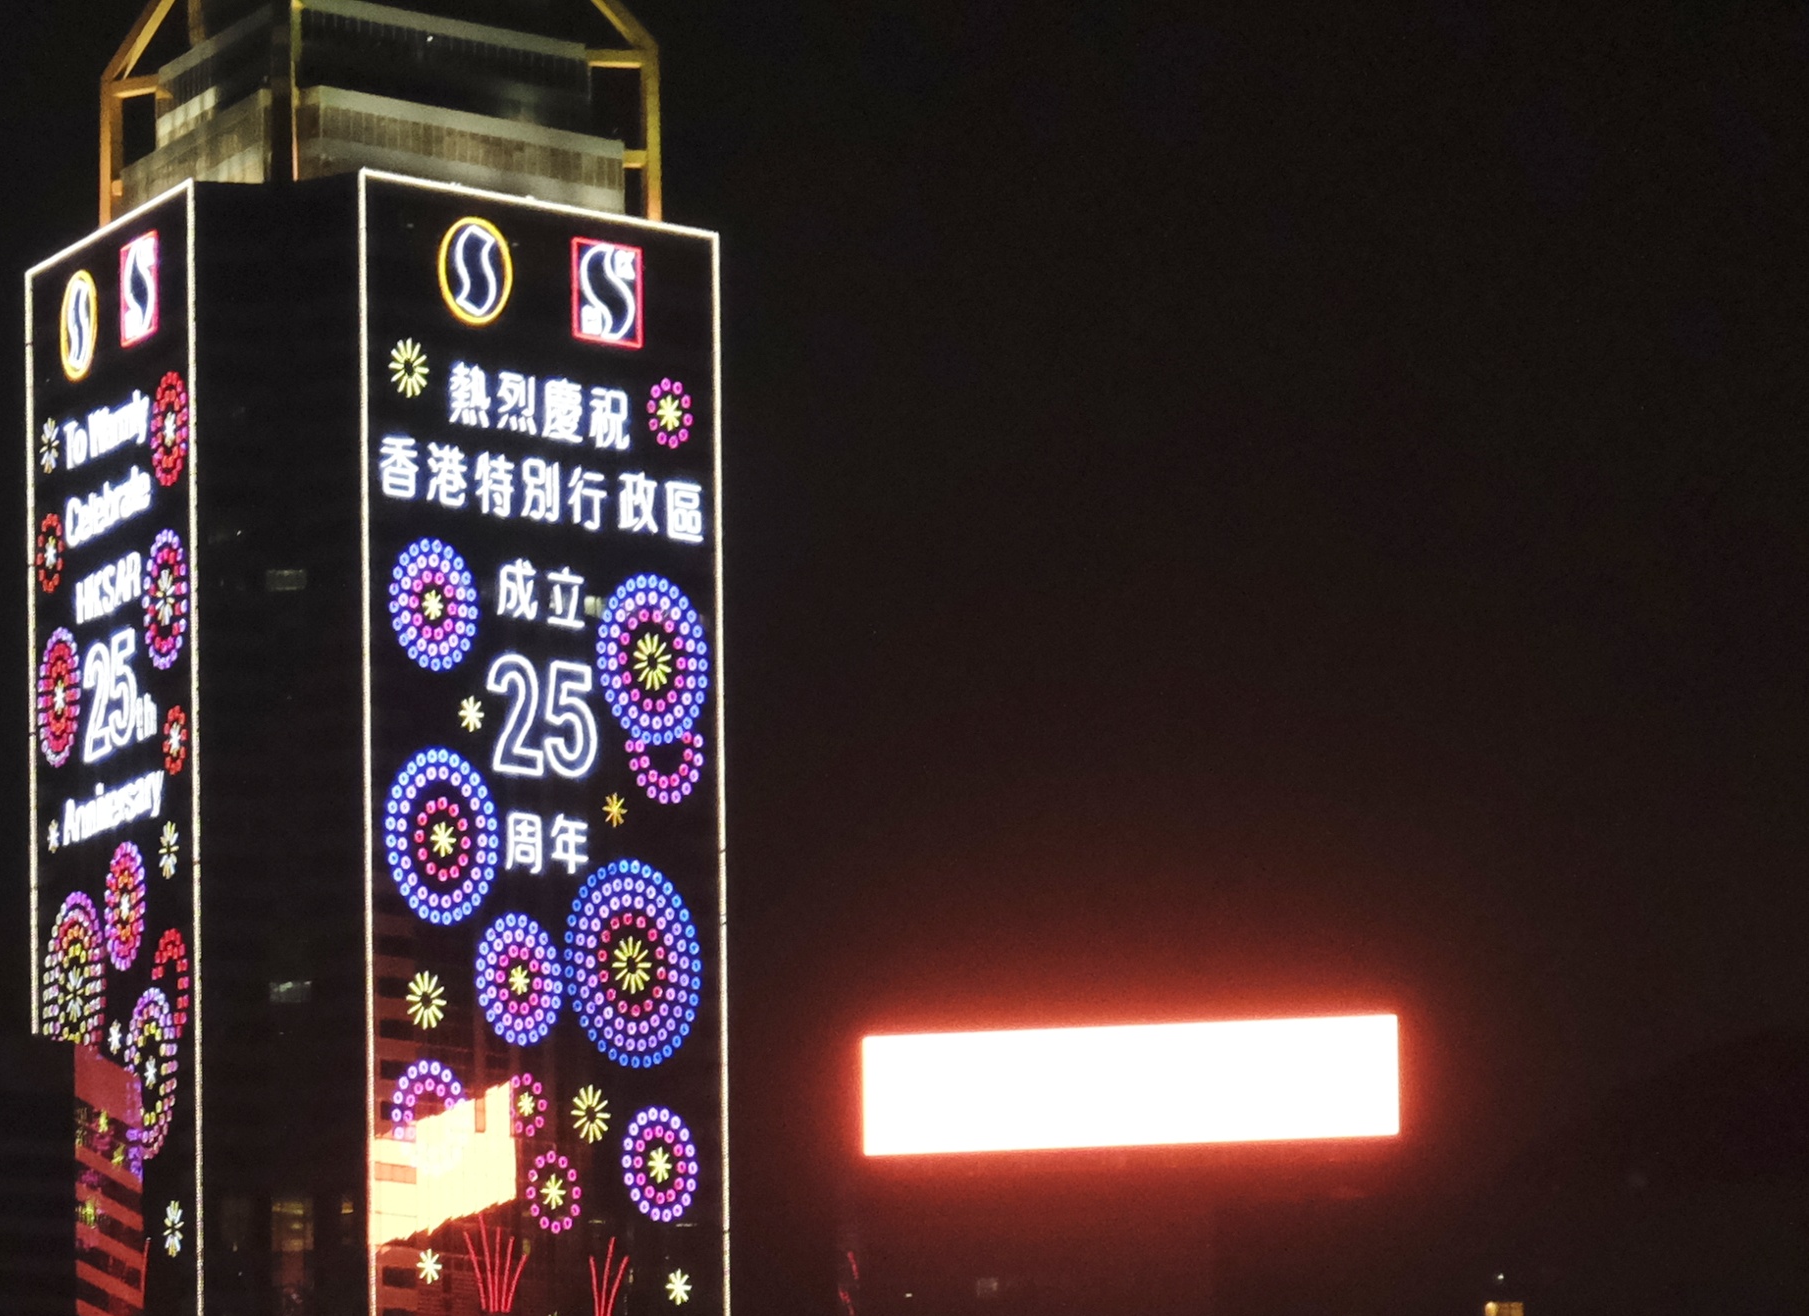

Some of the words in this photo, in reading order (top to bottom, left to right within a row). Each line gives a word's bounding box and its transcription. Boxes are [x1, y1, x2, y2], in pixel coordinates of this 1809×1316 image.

[63, 419, 88, 470] To
[448, 361, 631, 450] 熱烈慶祝
[65, 465, 152, 549] Celebrate
[379, 434, 705, 544] 香港特別行政區
[75, 552, 142, 625] HKSAR
[496, 558, 586, 628] 成立
[486, 653, 599, 778] 25
[505, 811, 590, 875] 周年
